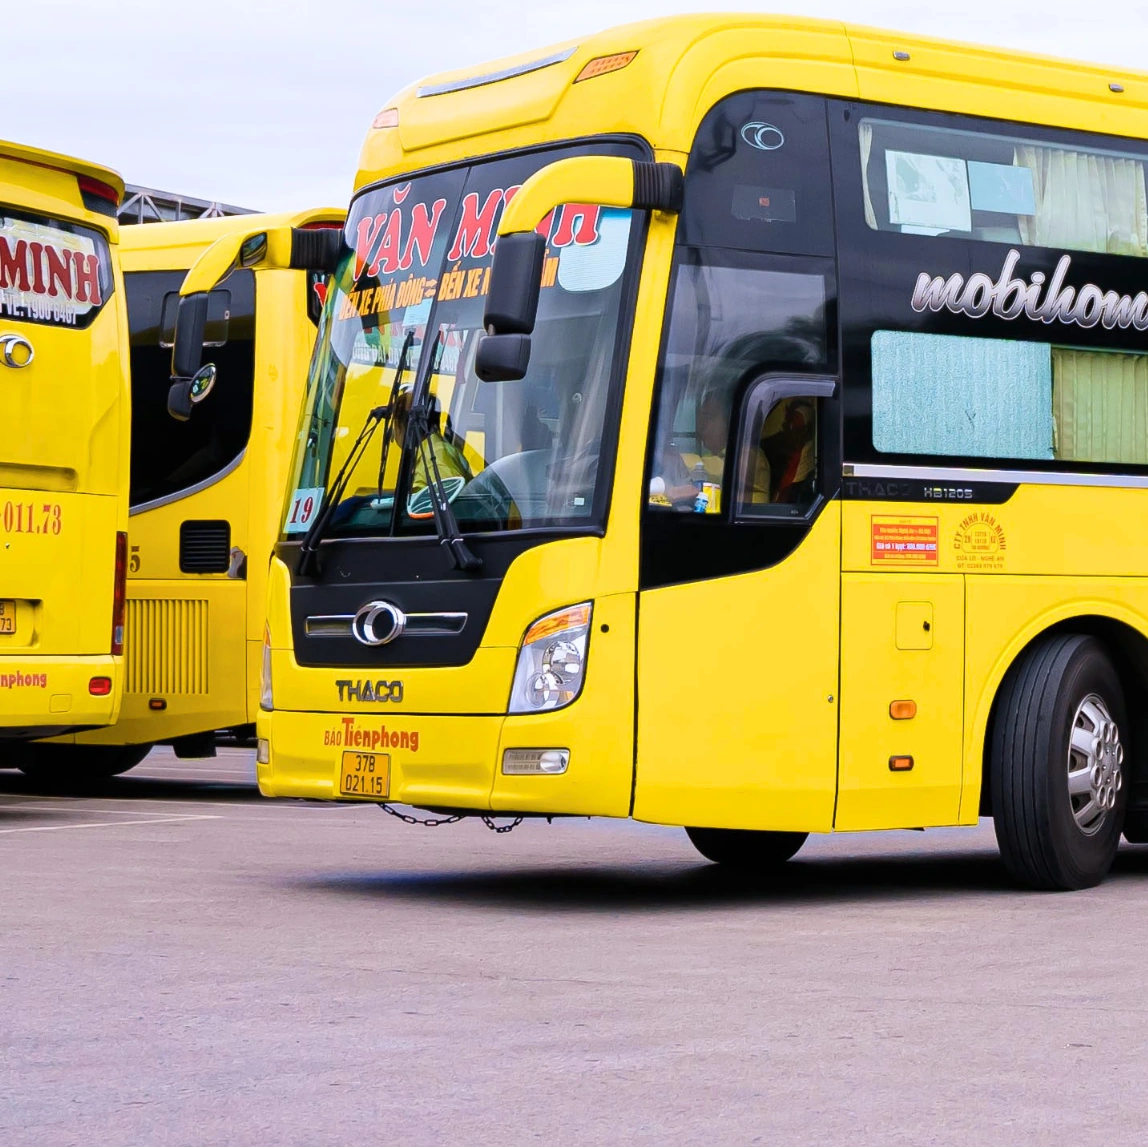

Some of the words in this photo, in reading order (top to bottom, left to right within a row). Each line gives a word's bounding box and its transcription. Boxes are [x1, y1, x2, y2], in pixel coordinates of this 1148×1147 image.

[353, 182, 447, 281] VĂN
[447, 185, 599, 261] MH
[0, 236, 102, 306] MINH
[358, 288, 374, 316] XE
[372, 279, 397, 313] PHÍA
[438, 261, 465, 301] BẾN
[463, 267, 485, 298] XE
[0, 501, 61, 535] 011.73
[289, 496, 313, 523] 19
[994, 525, 1006, 550] MINH
[336, 680, 404, 703] THACO
[324, 727, 342, 746] BÁO
[355, 755, 376, 772] 37B
[345, 774, 382, 794] 021.15
